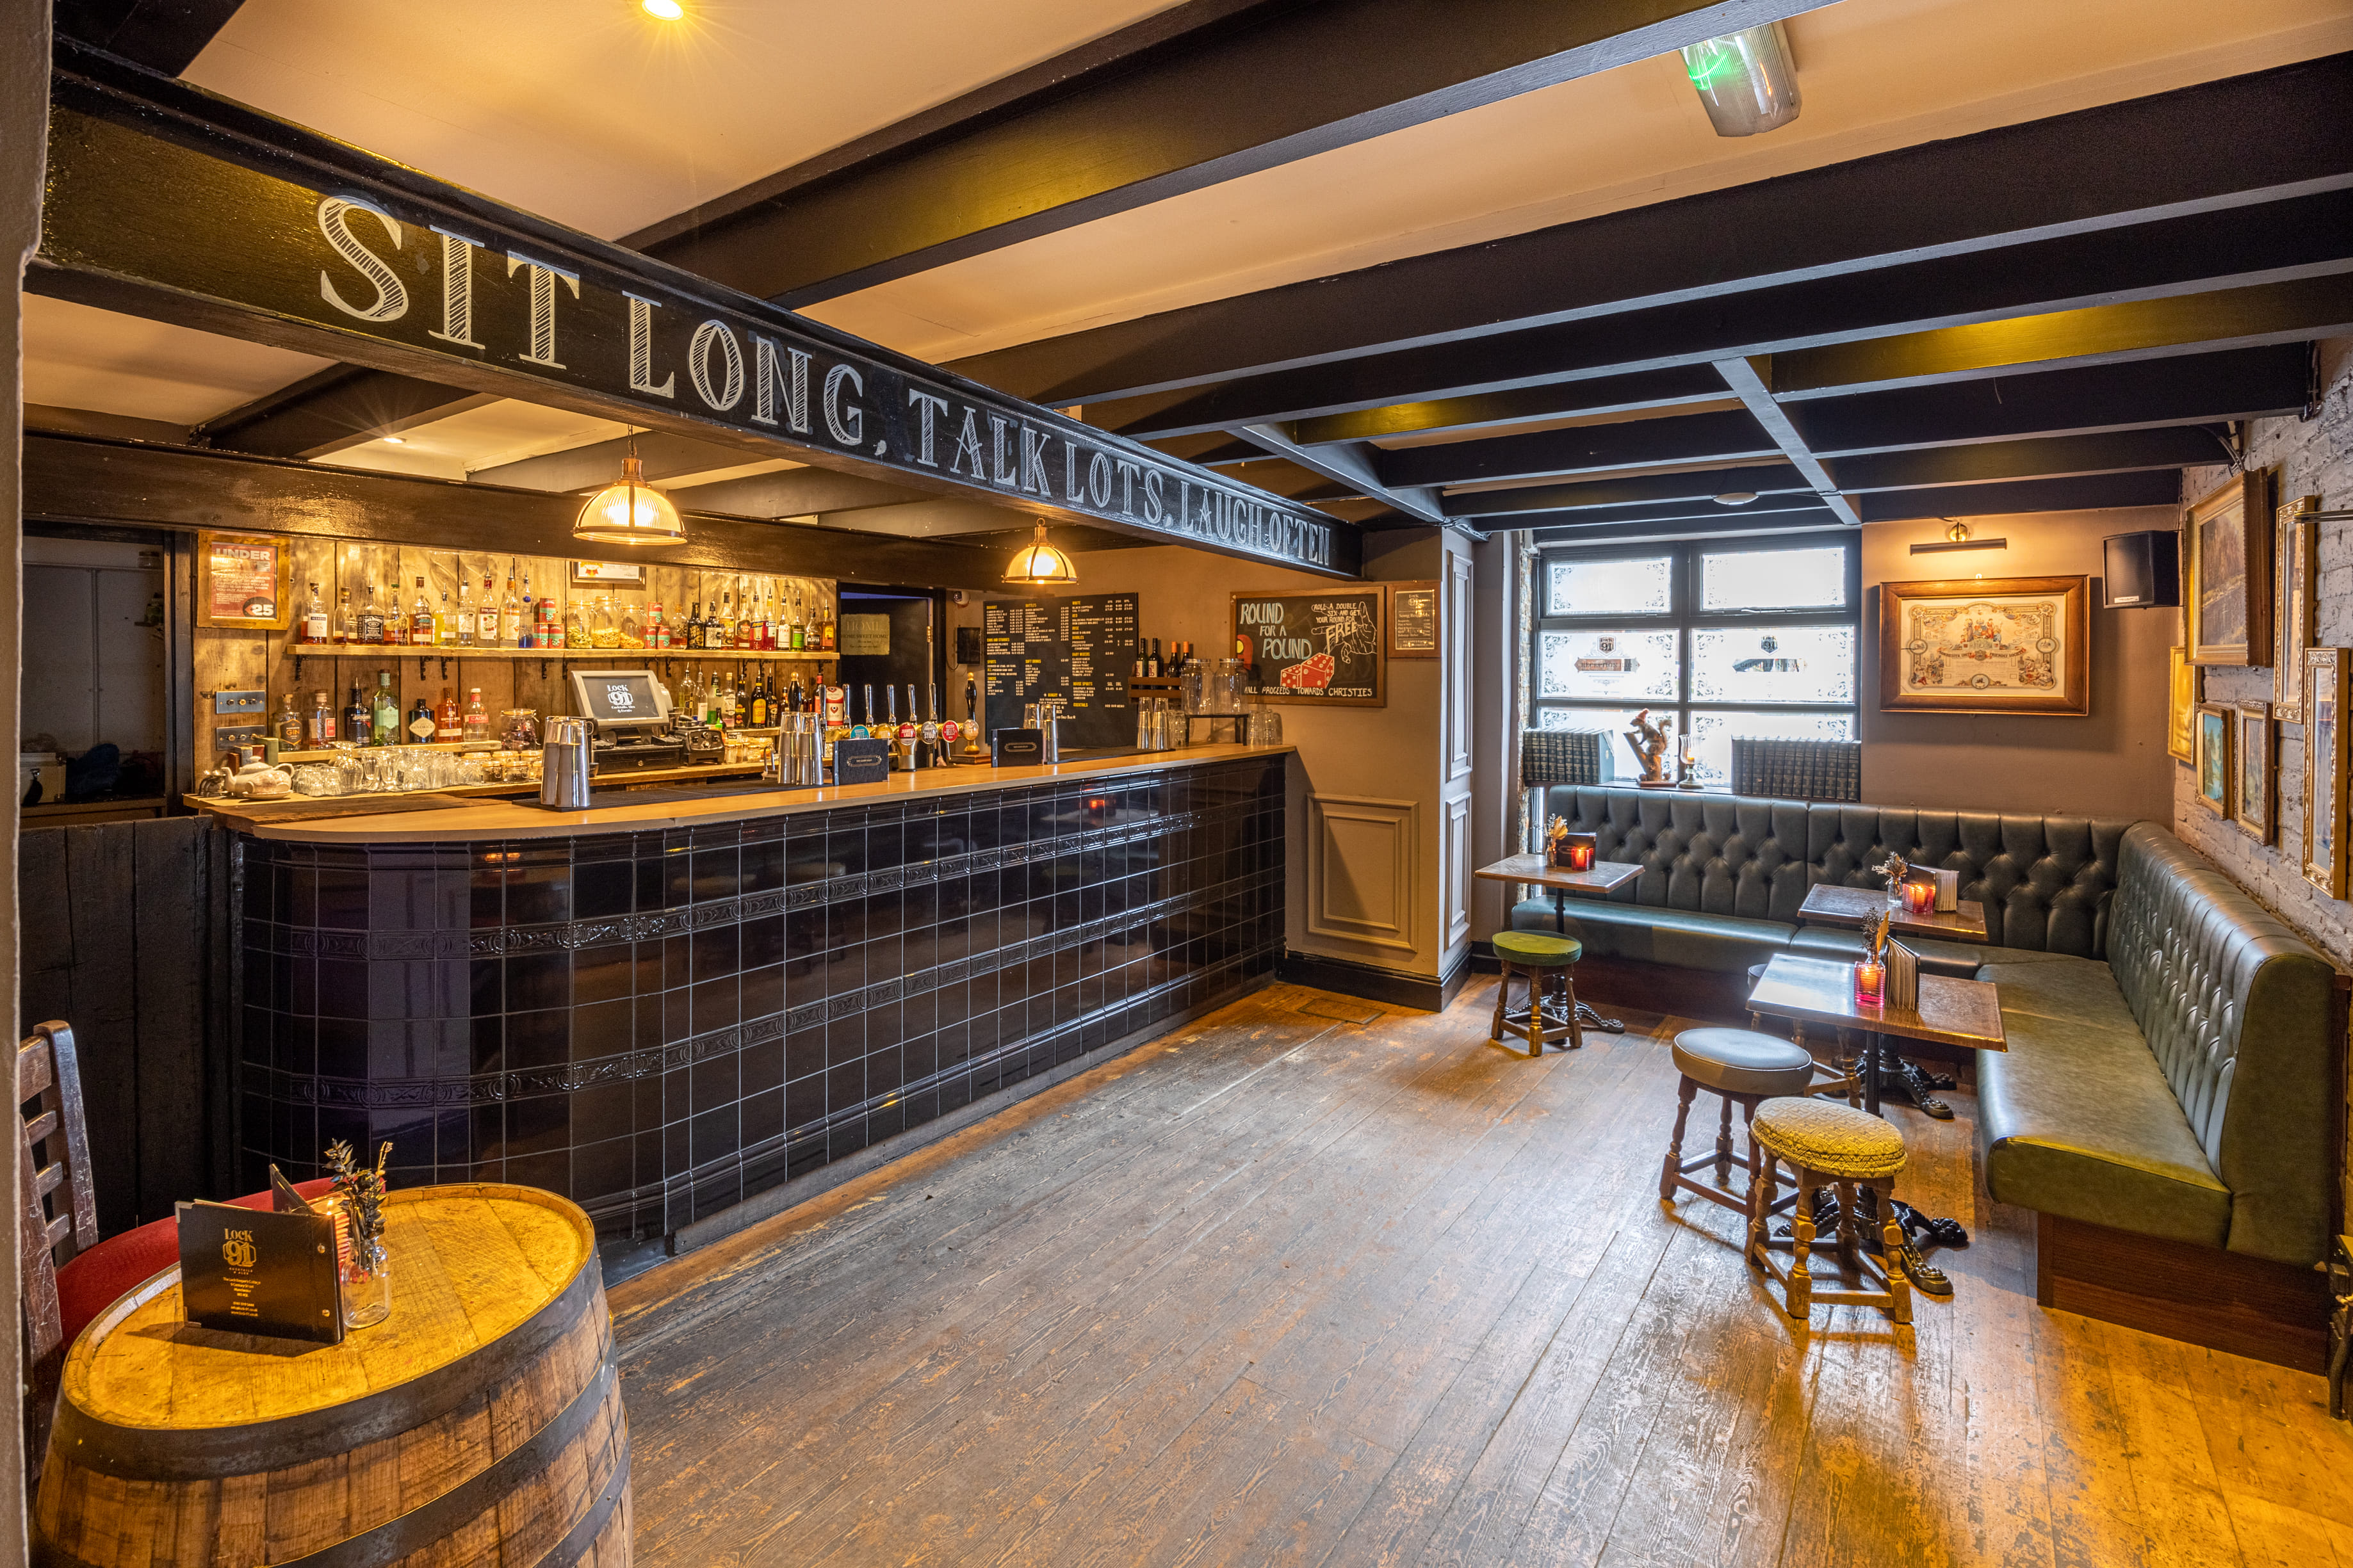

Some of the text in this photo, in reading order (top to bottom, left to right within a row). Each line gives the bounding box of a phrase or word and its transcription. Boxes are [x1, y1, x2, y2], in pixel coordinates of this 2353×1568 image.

[318, 194, 1331, 566] SIT LONG, TALK LOTS, LAUGH OFTEN
[216, 548, 270, 560] UNDER
[252, 604, 273, 616] 25
[1240, 602, 1284, 624] ROUND
[1260, 625, 1287, 636] FOR A
[1326, 622, 1357, 656] FREE
[1262, 638, 1312, 659] POUND
[1601, 643, 1611, 651] 91
[610, 691, 632, 705] 91
[1296, 687, 1324, 695] TOWARDS
[1328, 688, 1372, 697] CHRISTIES
[226, 1240, 254, 1267] 91
